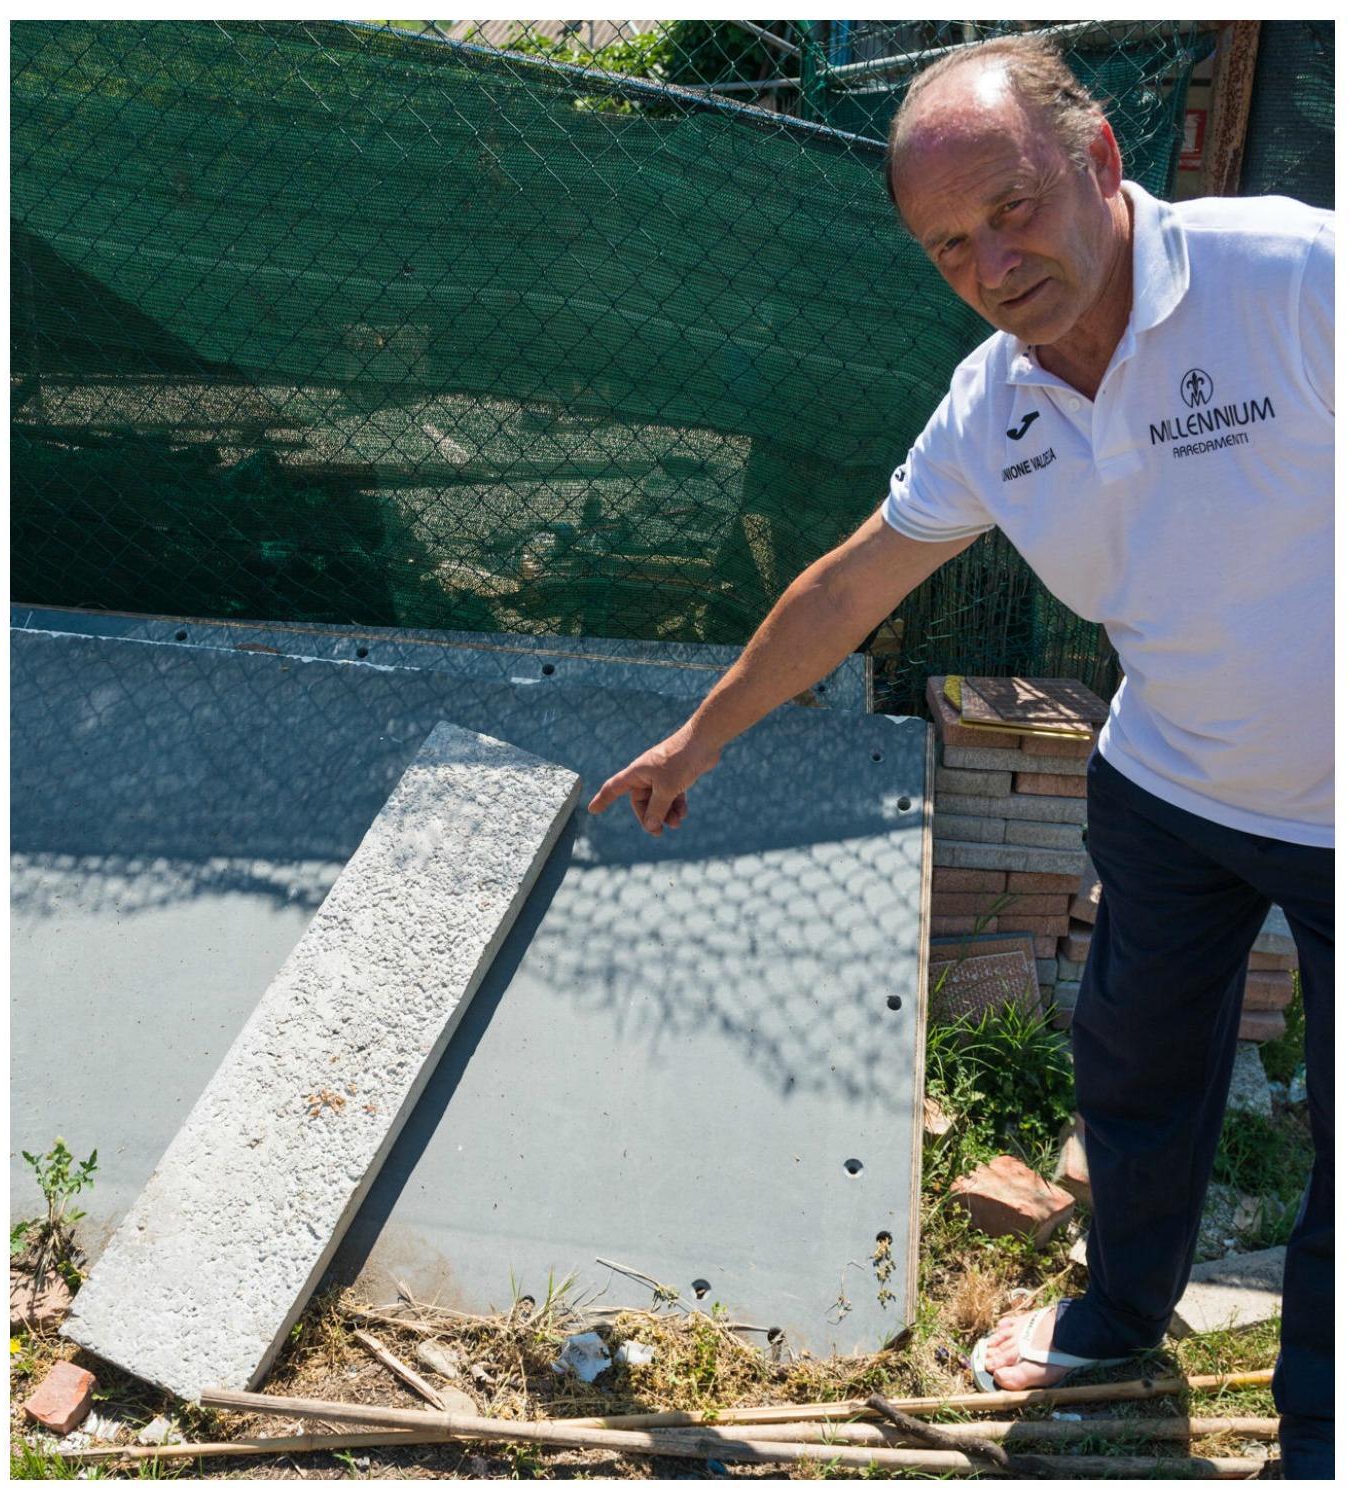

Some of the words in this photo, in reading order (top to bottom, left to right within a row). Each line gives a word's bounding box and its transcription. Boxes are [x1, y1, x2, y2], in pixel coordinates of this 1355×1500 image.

[1149, 396, 1276, 446] MILLENNIUM
[1172, 432, 1250, 459] ARREDAMENTI
[1001, 459, 1032, 482] NIONE
